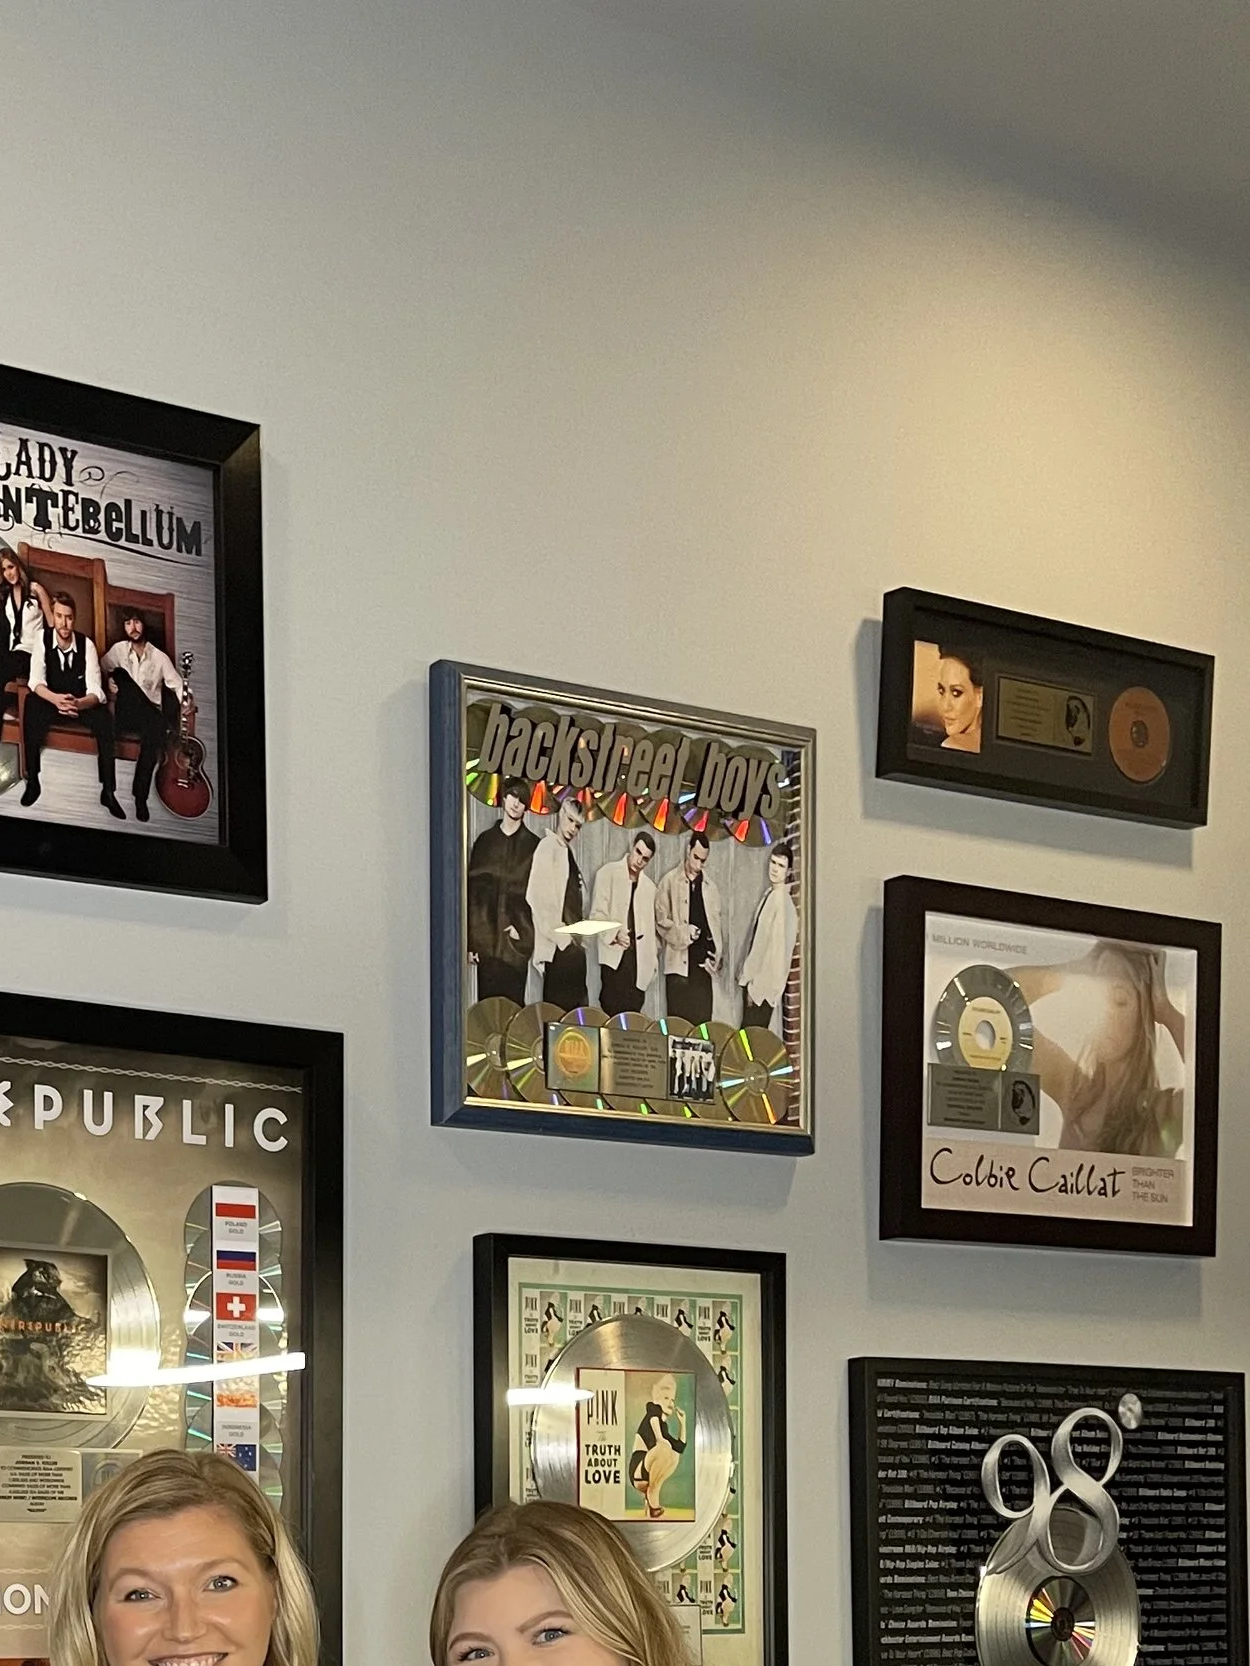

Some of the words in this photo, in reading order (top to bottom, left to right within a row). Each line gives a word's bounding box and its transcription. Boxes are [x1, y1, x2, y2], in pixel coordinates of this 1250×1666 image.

[478, 702, 692, 800] backstreet
[697, 741, 786, 820] boys
[930, 1147, 1021, 1191] Colbie
[1028, 1156, 1127, 1199] Caillat
[584, 1443, 622, 1457] TRUTH
[587, 1457, 619, 1468] ABOUT
[584, 1469, 622, 1485] LOVE
